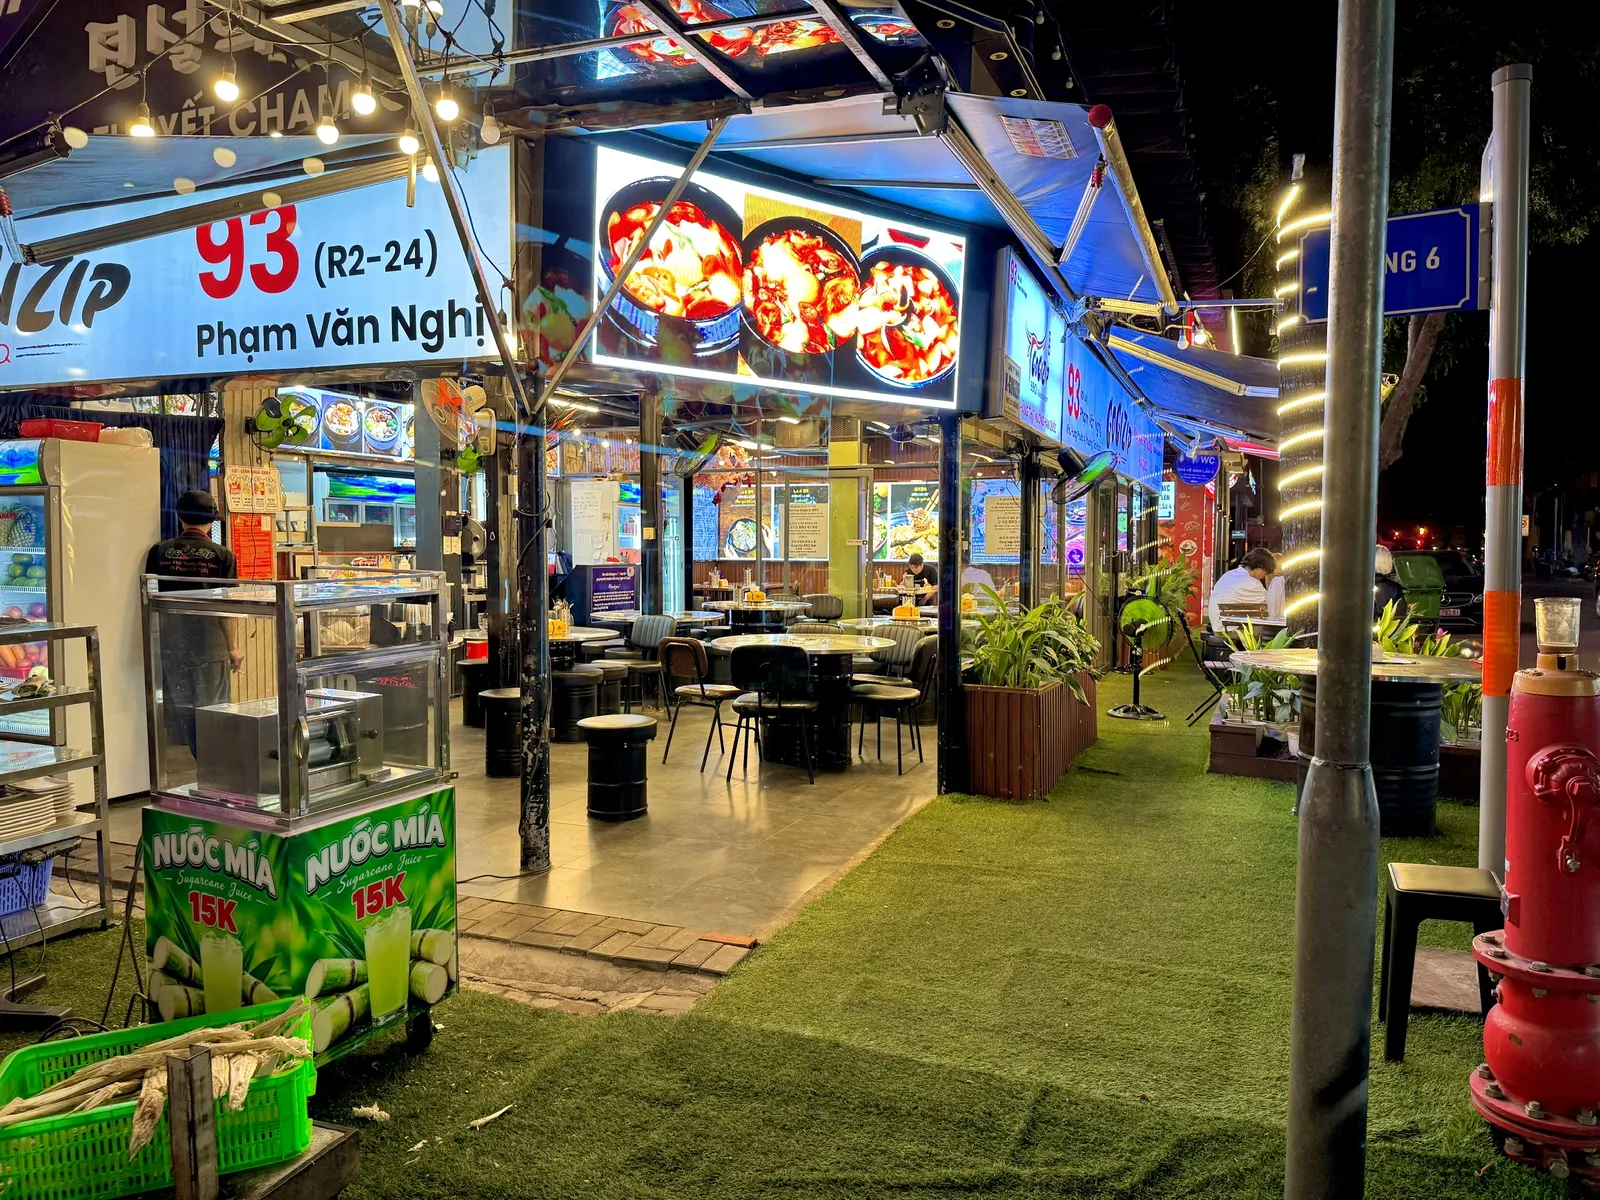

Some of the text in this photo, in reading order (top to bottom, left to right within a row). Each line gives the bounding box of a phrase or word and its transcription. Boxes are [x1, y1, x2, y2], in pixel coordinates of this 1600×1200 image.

[195, 204, 438, 299] 93 (R2-24)
[1425, 246, 1441, 270] 6
[196, 293, 485, 363] Phạm Văn Nghị
[1068, 363, 1081, 420] 93
[1200, 455, 1215, 465] WC
[152, 824, 279, 900] NƯỚC MÍA
[305, 803, 447, 896] NƯỚC MÍA
[337, 854, 422, 894] Sugarcane Juice
[176, 869, 253, 902] Sugarcane Juice
[352, 870, 408, 920] 15K
[188, 891, 238, 935] 15K
